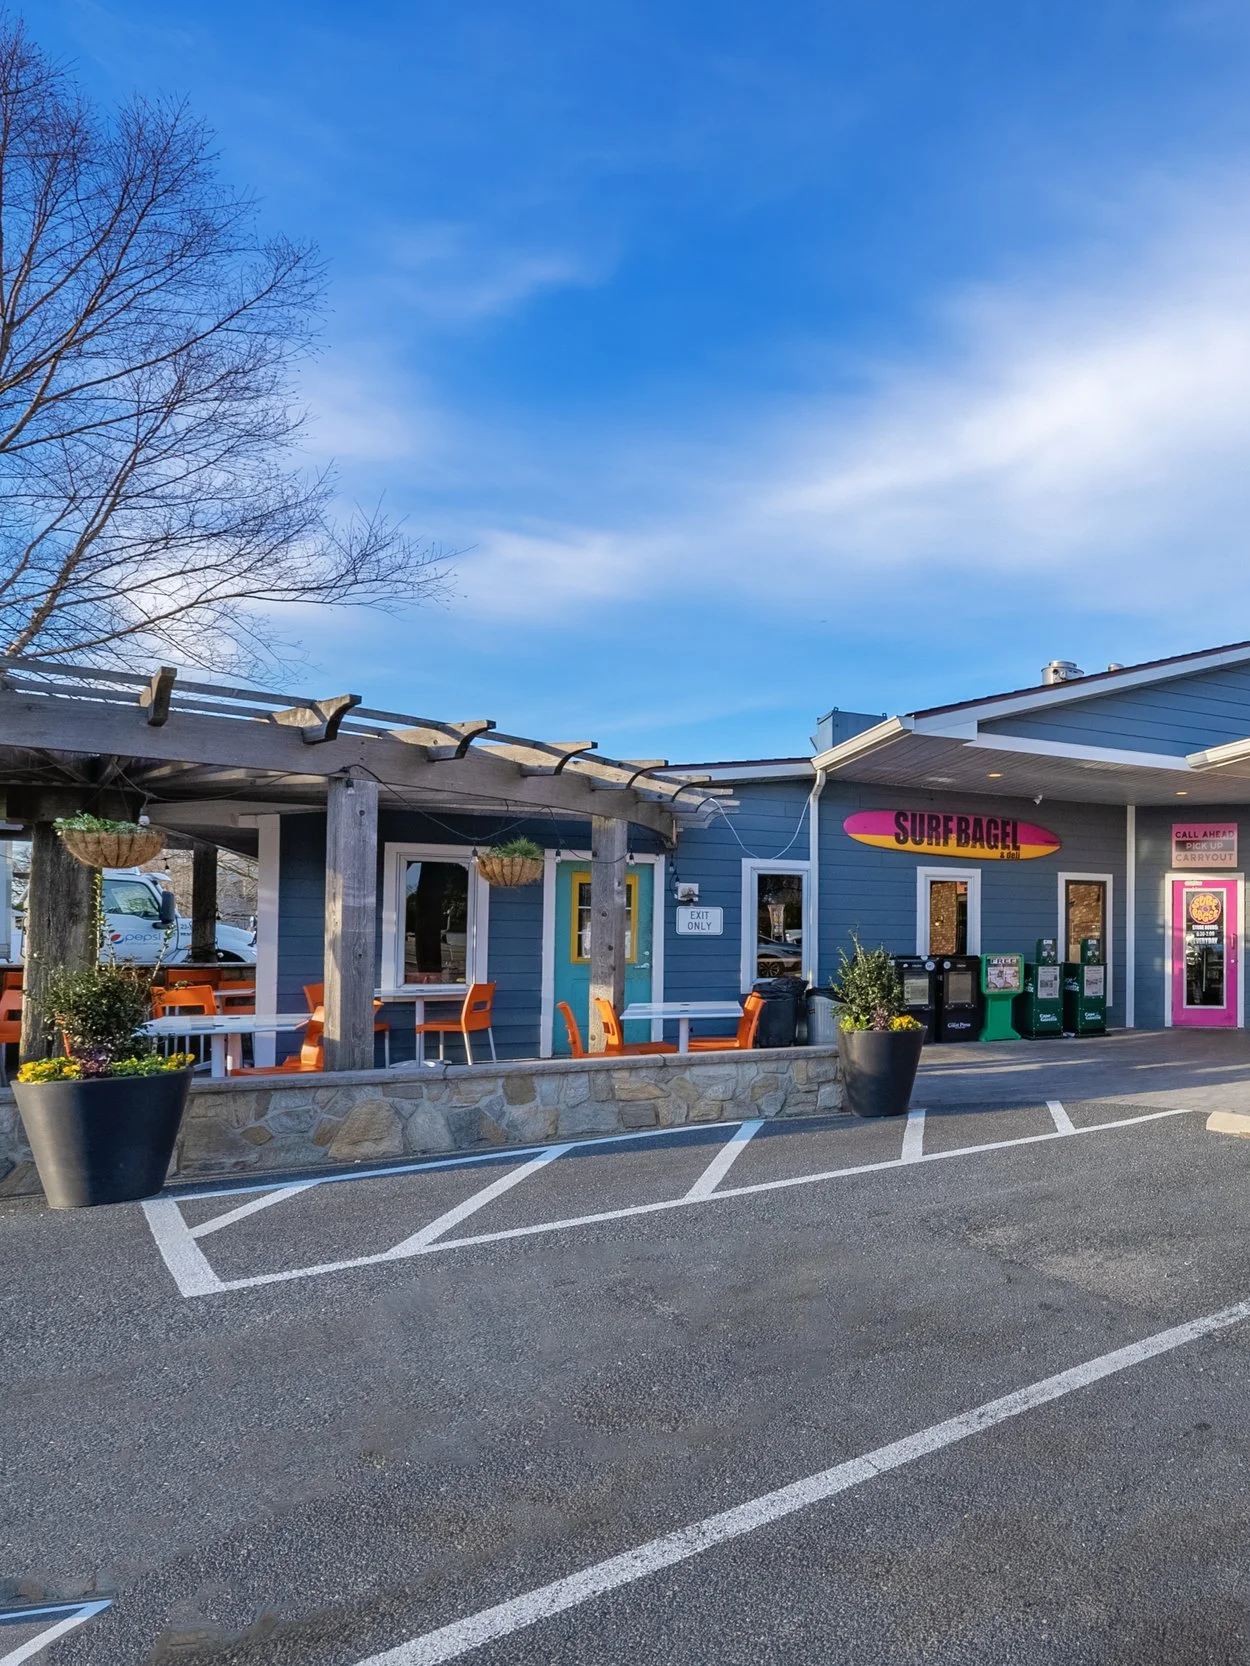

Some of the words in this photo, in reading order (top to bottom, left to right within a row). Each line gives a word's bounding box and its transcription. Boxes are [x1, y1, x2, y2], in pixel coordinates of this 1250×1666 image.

[1202, 830, 1235, 838] AHEAD
[1186, 842, 1208, 850] PICK
[1006, 851, 1020, 860] deli
[1175, 853, 1234, 862] CARRYOUT
[1192, 895, 1218, 910] SURF
[690, 911, 709, 920] EXIT
[688, 921, 711, 930] ONLY
[125, 933, 161, 943] pepsi
